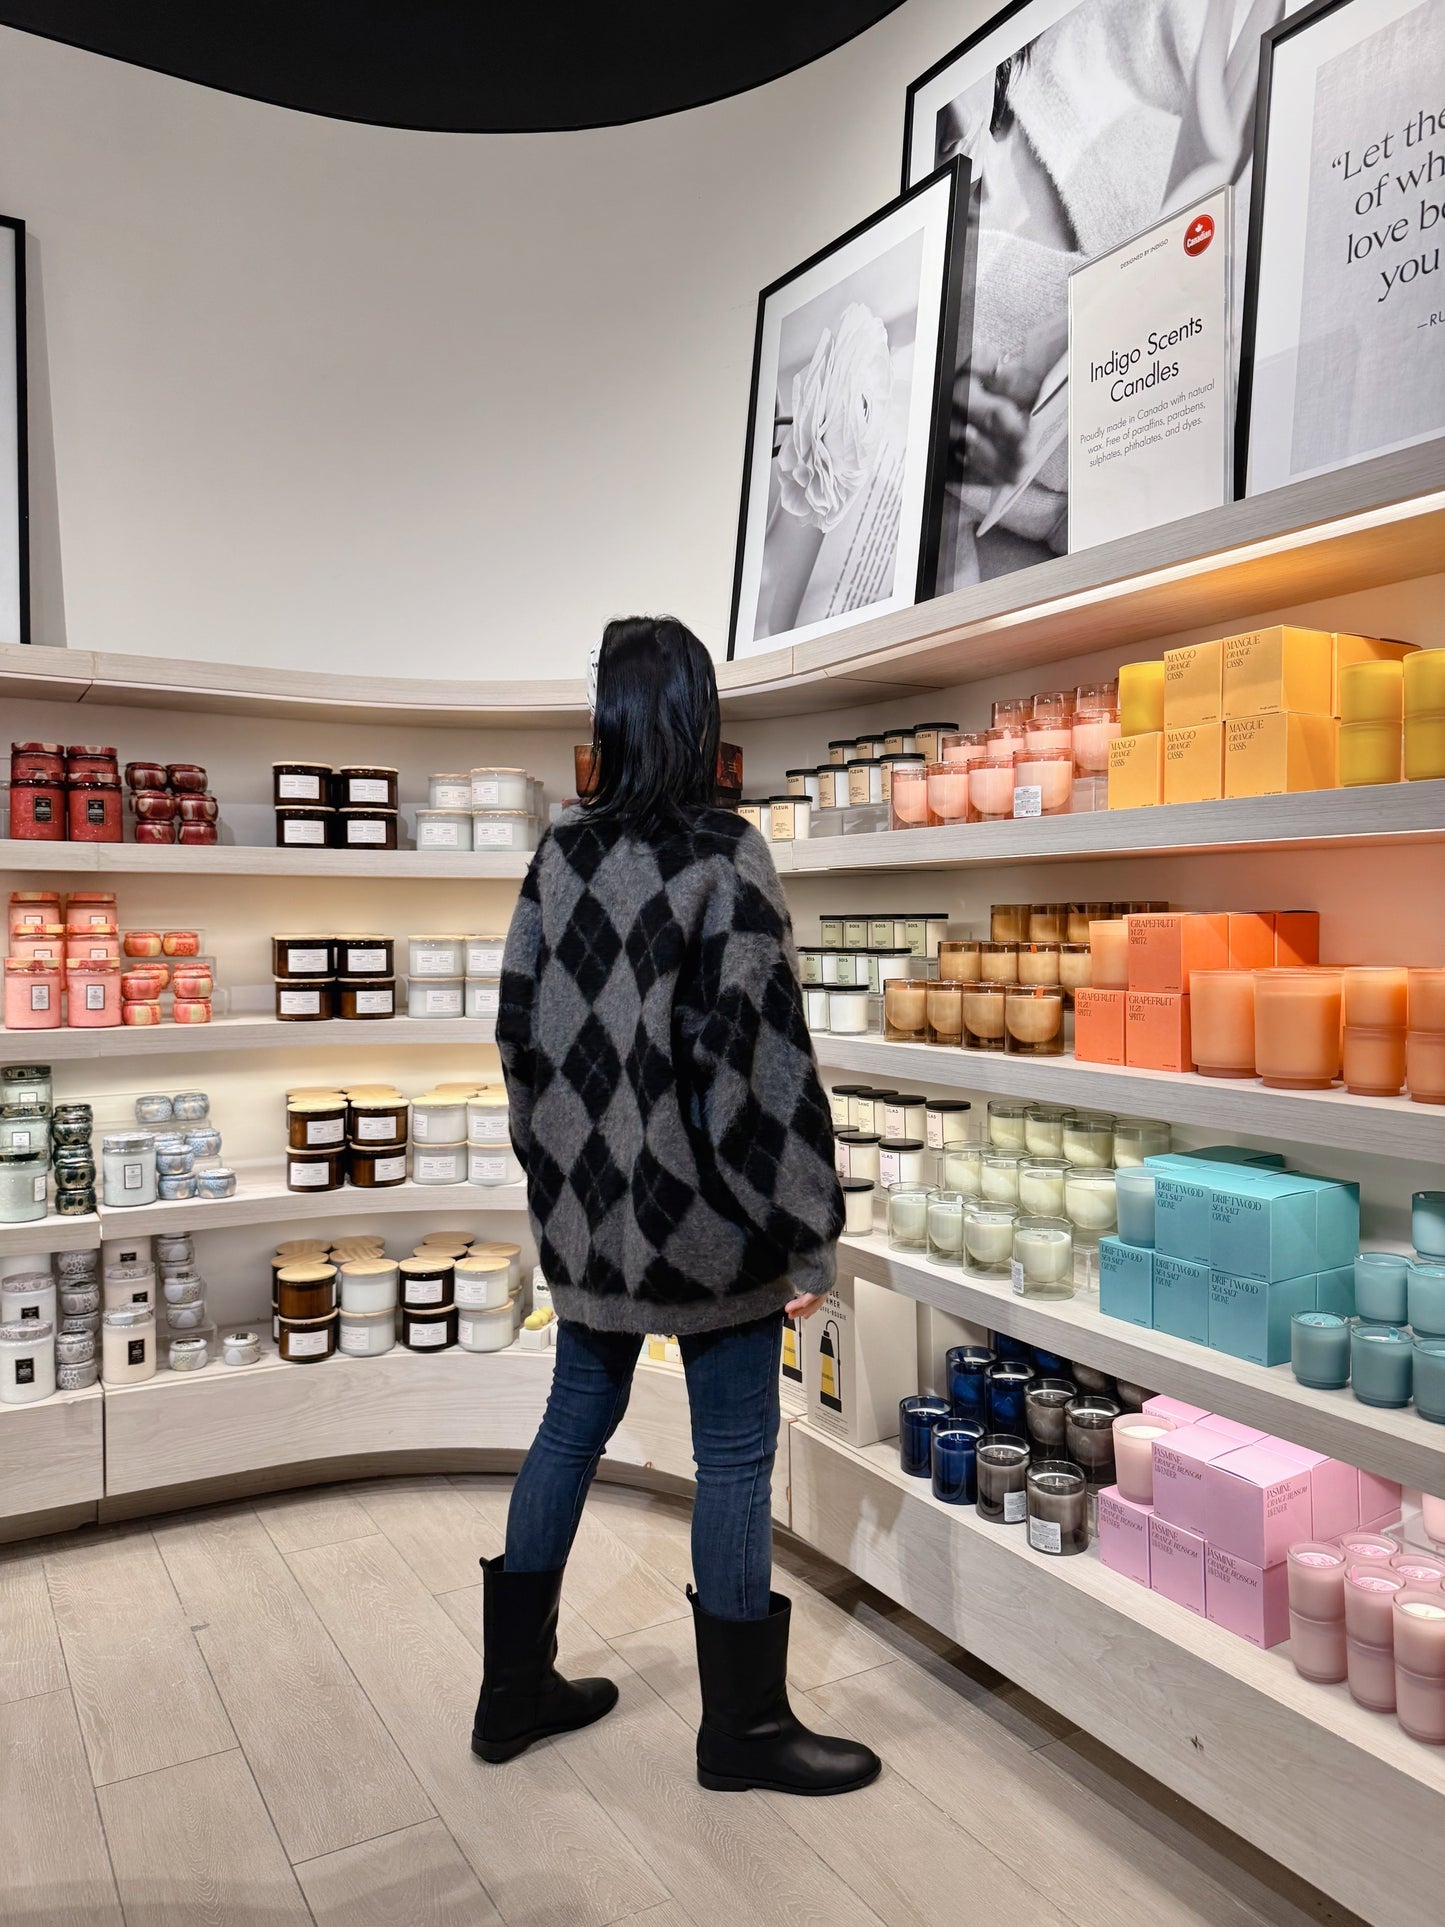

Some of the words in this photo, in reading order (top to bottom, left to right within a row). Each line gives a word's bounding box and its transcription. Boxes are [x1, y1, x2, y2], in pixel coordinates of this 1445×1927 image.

[1331, 131, 1395, 181] “Let
[1355, 172, 1390, 215] of
[1346, 218, 1409, 265] love
[1420, 199, 1445, 231] b
[1120, 253, 1143, 269] DESIGNED
[1144, 249, 1150, 257] BY
[1150, 238, 1169, 253] INDIGO
[1377, 248, 1440, 303] you
[1090, 348, 1141, 383] Indigo
[1147, 317, 1203, 355] Scents
[1110, 360, 1179, 403] Candles
[1080, 427, 1105, 444] Proudly
[1106, 417, 1127, 433] made
[1128, 415, 1136, 424] in
[1137, 401, 1169, 420] Canada
[1170, 391, 1186, 406] with
[1188, 378, 1215, 399] natural
[1087, 443, 1104, 454] wax.
[1105, 435, 1121, 447] Free
[1122, 428, 1131, 440] of
[1131, 418, 1166, 440] paraffins,
[1167, 401, 1206, 425] parabens,
[1089, 450, 1123, 467] sulphates,
[1124, 433, 1163, 456] phthalates,
[1165, 425, 1180, 438] and
[1182, 417, 1203, 432] dyes.
[1227, 634, 1261, 650] MANGUE
[1167, 650, 1196, 663] MANGO
[1226, 647, 1252, 659] ORANGE
[1166, 661, 1191, 671] ORANGE
[1226, 659, 1244, 669] CASSIS
[1167, 672, 1184, 681] CASSIS
[1229, 720, 1264, 734] MANGUE
[1110, 739, 1136, 751] MANGO
[1167, 730, 1196, 743] MANGO
[1229, 732, 1256, 742] ORANGE
[1110, 749, 1132, 758] ORANGE
[1166, 741, 1192, 751] ORANGE
[1229, 742, 1247, 752] CASSIS
[1167, 751, 1184, 760] CASSIS
[1130, 919, 1176, 929] GRAPEFRUIT
[1077, 991, 1117, 1003] GRAPEFRUIT
[1129, 995, 1175, 1007] GRAPEFRUIT
[1157, 1180, 1204, 1198] DRIFTWOOD
[1212, 1193, 1262, 1211] DRIFTWOOD
[1101, 1243, 1143, 1264] DRIFTWOOD
[1155, 1258, 1200, 1278] DRIFTWOOD
[1212, 1273, 1259, 1295] DRIFTWOOD
[1154, 1446, 1182, 1465] JASMINE
[1266, 1482, 1292, 1500] JASMINE
[1100, 1497, 1125, 1516] JASMINE
[1152, 1521, 1178, 1541] JASMINE
[1207, 1547, 1236, 1569] JASMINE
